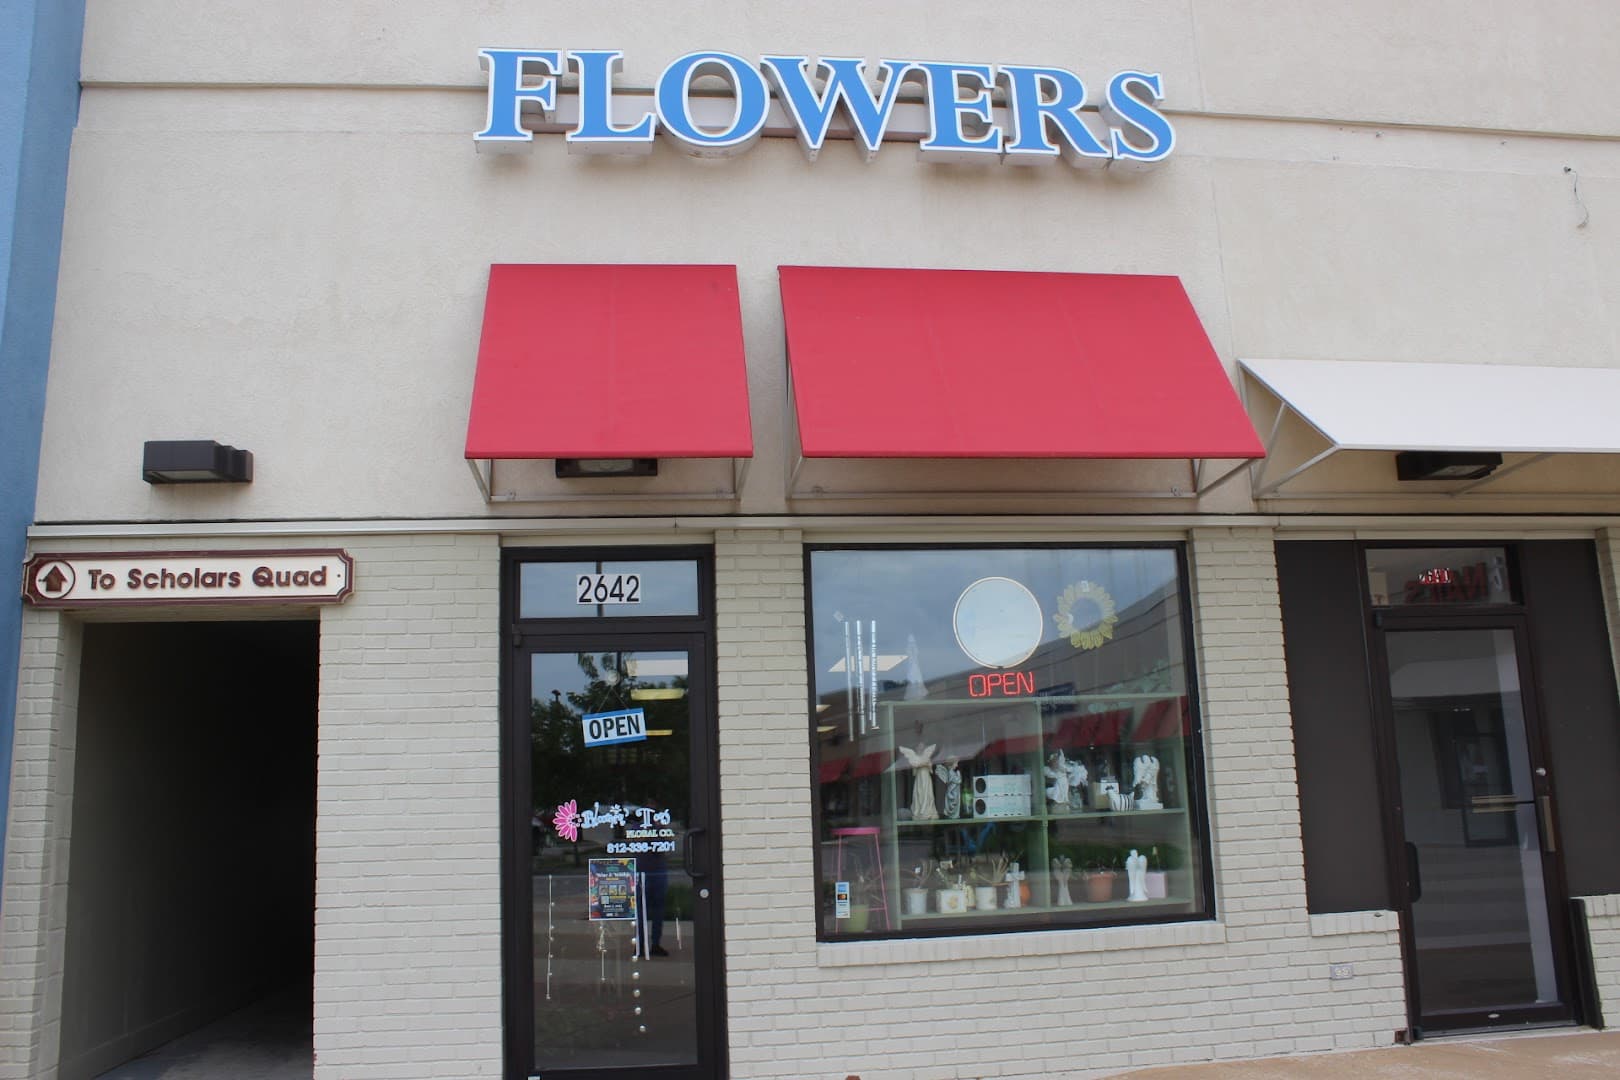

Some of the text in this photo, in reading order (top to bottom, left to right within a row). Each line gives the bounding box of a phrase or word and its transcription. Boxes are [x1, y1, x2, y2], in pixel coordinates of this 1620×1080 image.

[473, 47, 1177, 160] FLOWERS
[88, 565, 328, 590] To Scholars Quad
[578, 575, 640, 603] 2642
[968, 671, 1035, 697] OPEN
[589, 713, 641, 740] OPEN
